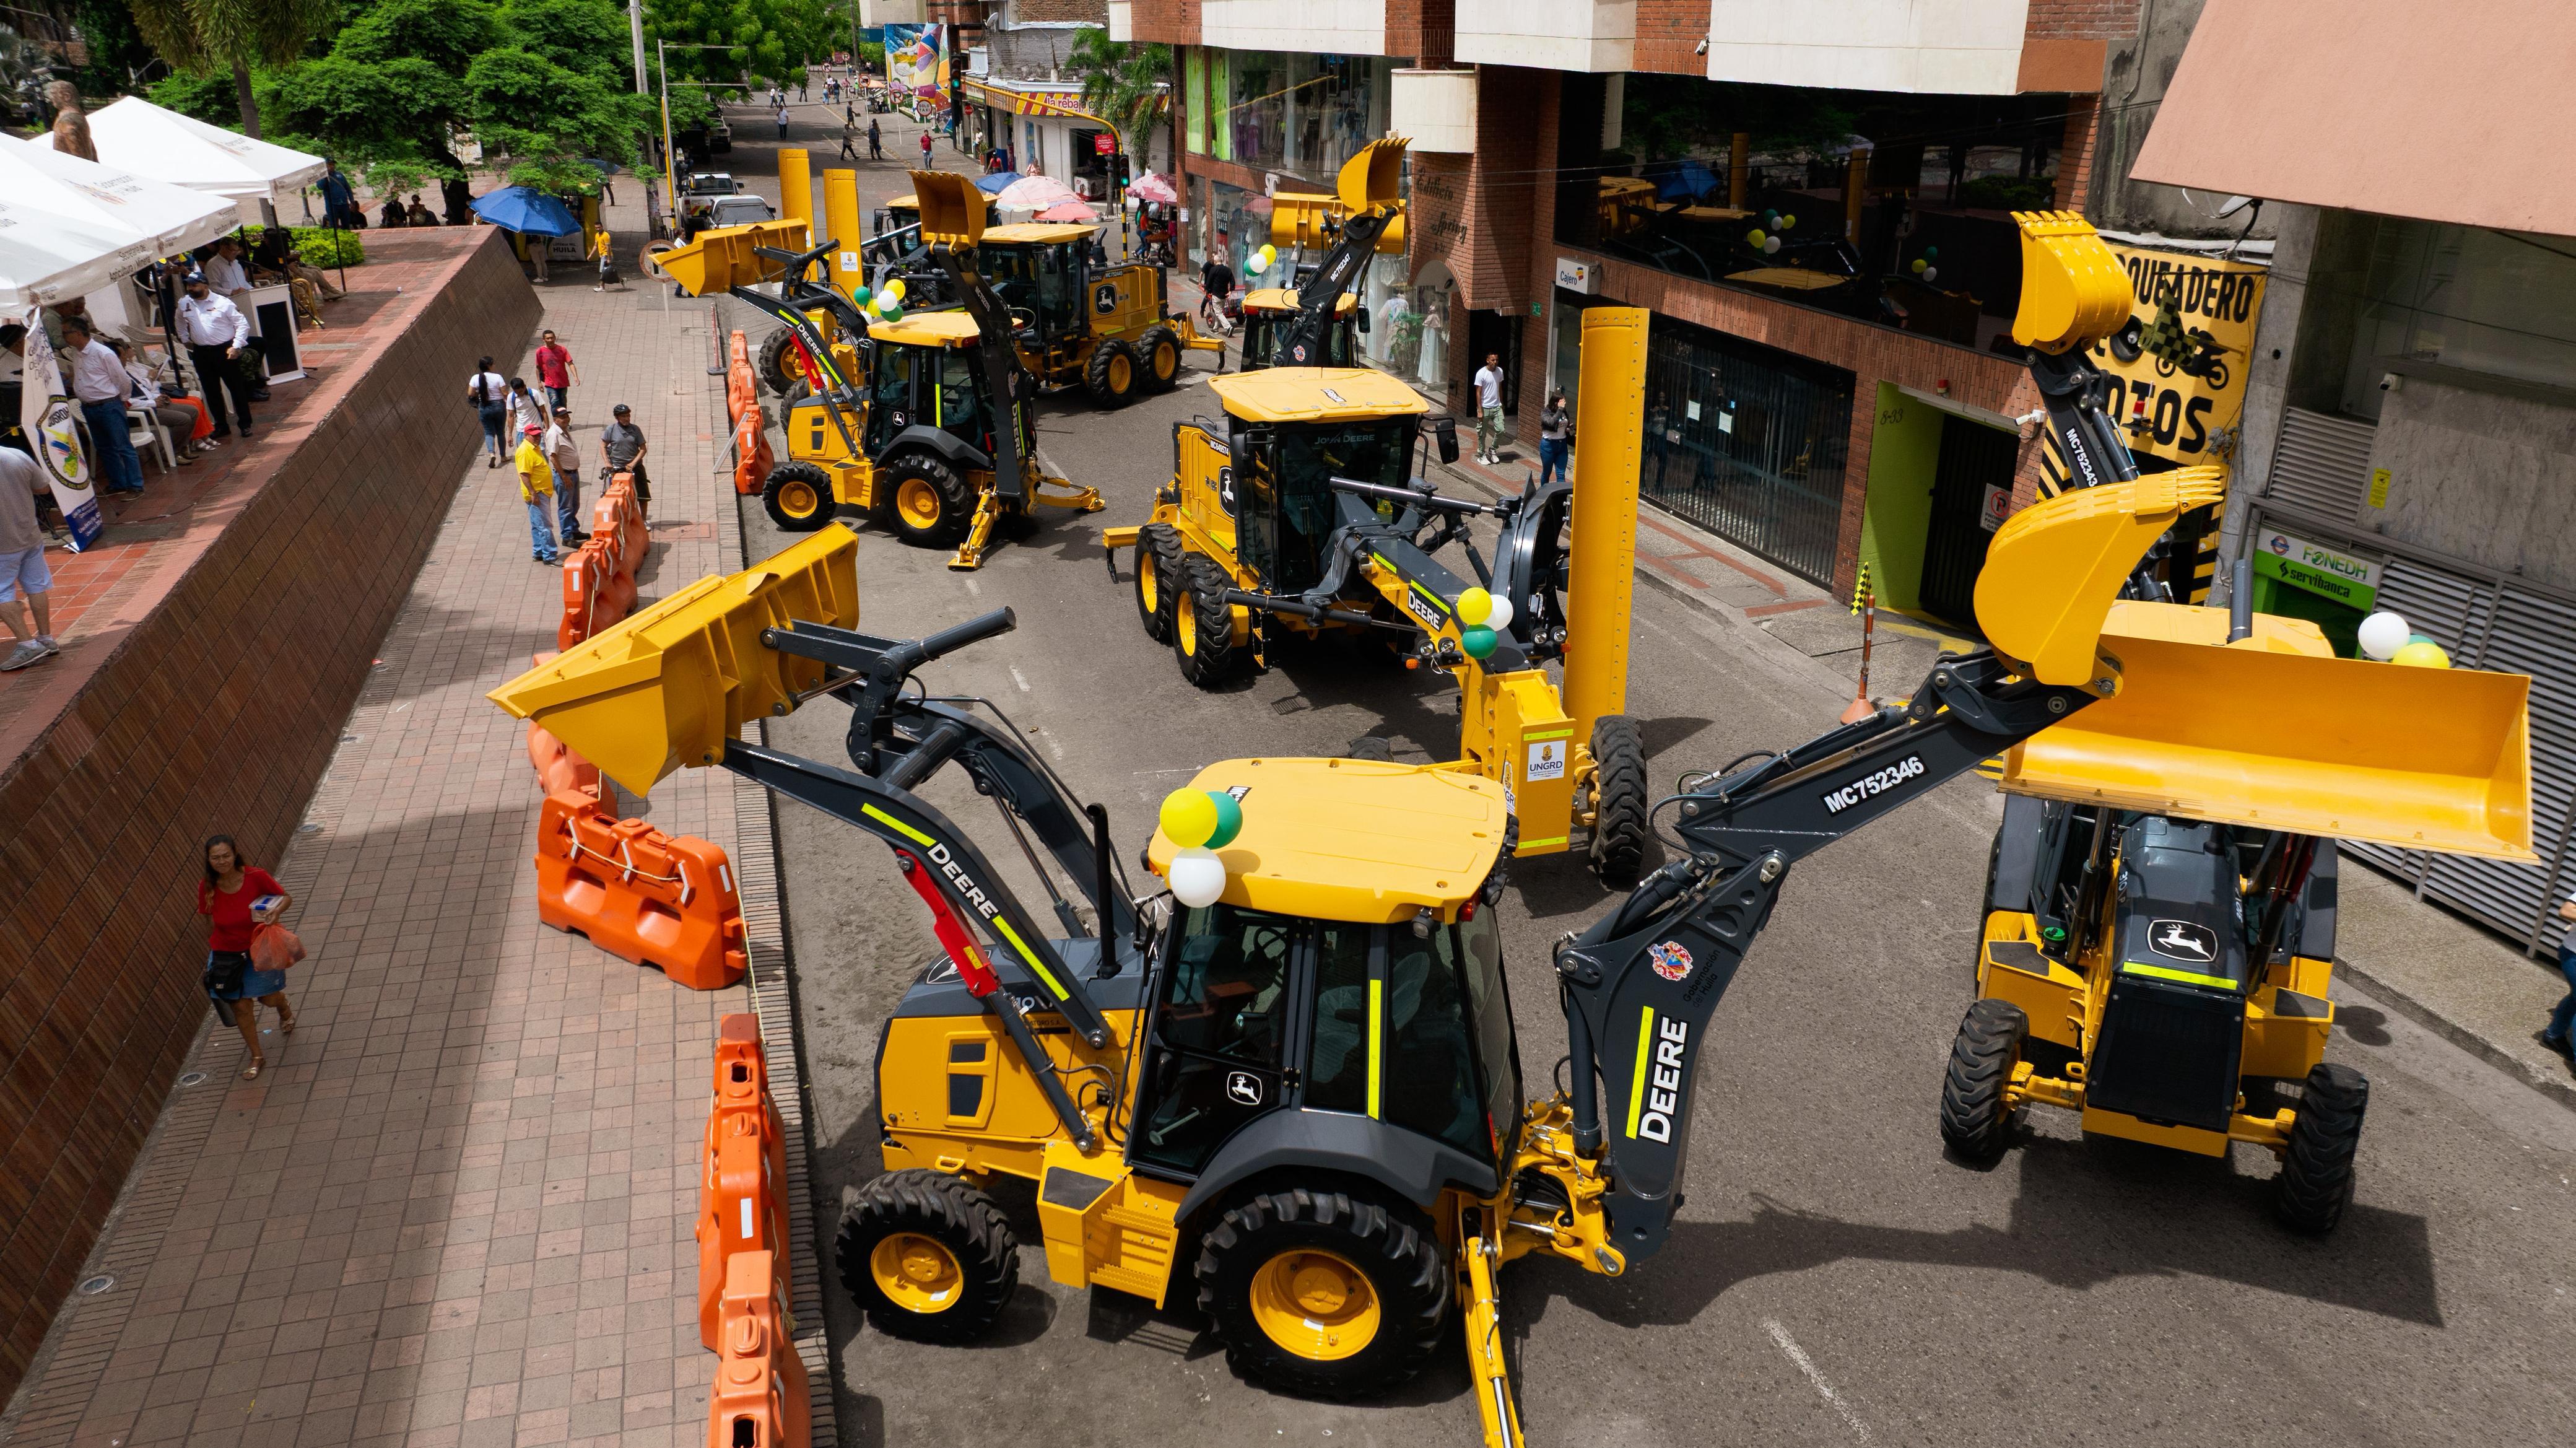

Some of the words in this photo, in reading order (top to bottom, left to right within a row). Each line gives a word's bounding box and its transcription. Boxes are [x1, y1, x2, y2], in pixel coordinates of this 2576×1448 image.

[1217, 211, 1228, 221] SUPER
[1218, 220, 1227, 232] SALE
[1330, 253, 1351, 282] MC752347
[1560, 270, 1577, 286] Cajero
[2115, 253, 2255, 323] QUEADERO
[797, 323, 822, 356] DEERE
[1881, 408, 1903, 425] 8-33
[2105, 373, 2214, 455] OTOS
[1012, 403, 1022, 459] DEERE
[1343, 435, 1375, 443] DEERE
[2066, 427, 2098, 487] MC752343
[2303, 546, 2369, 580] FONEDH
[2290, 569, 2351, 598] servibanca
[1408, 590, 1440, 630] DEERE
[1530, 761, 1563, 772] UNGRD
[1824, 756, 1925, 814] MC752346
[928, 843, 999, 919] DEERE
[1683, 950, 1720, 1002] Gobernación
[1699, 972, 1718, 996] Huila
[1639, 1016, 1687, 1145] DEERE
